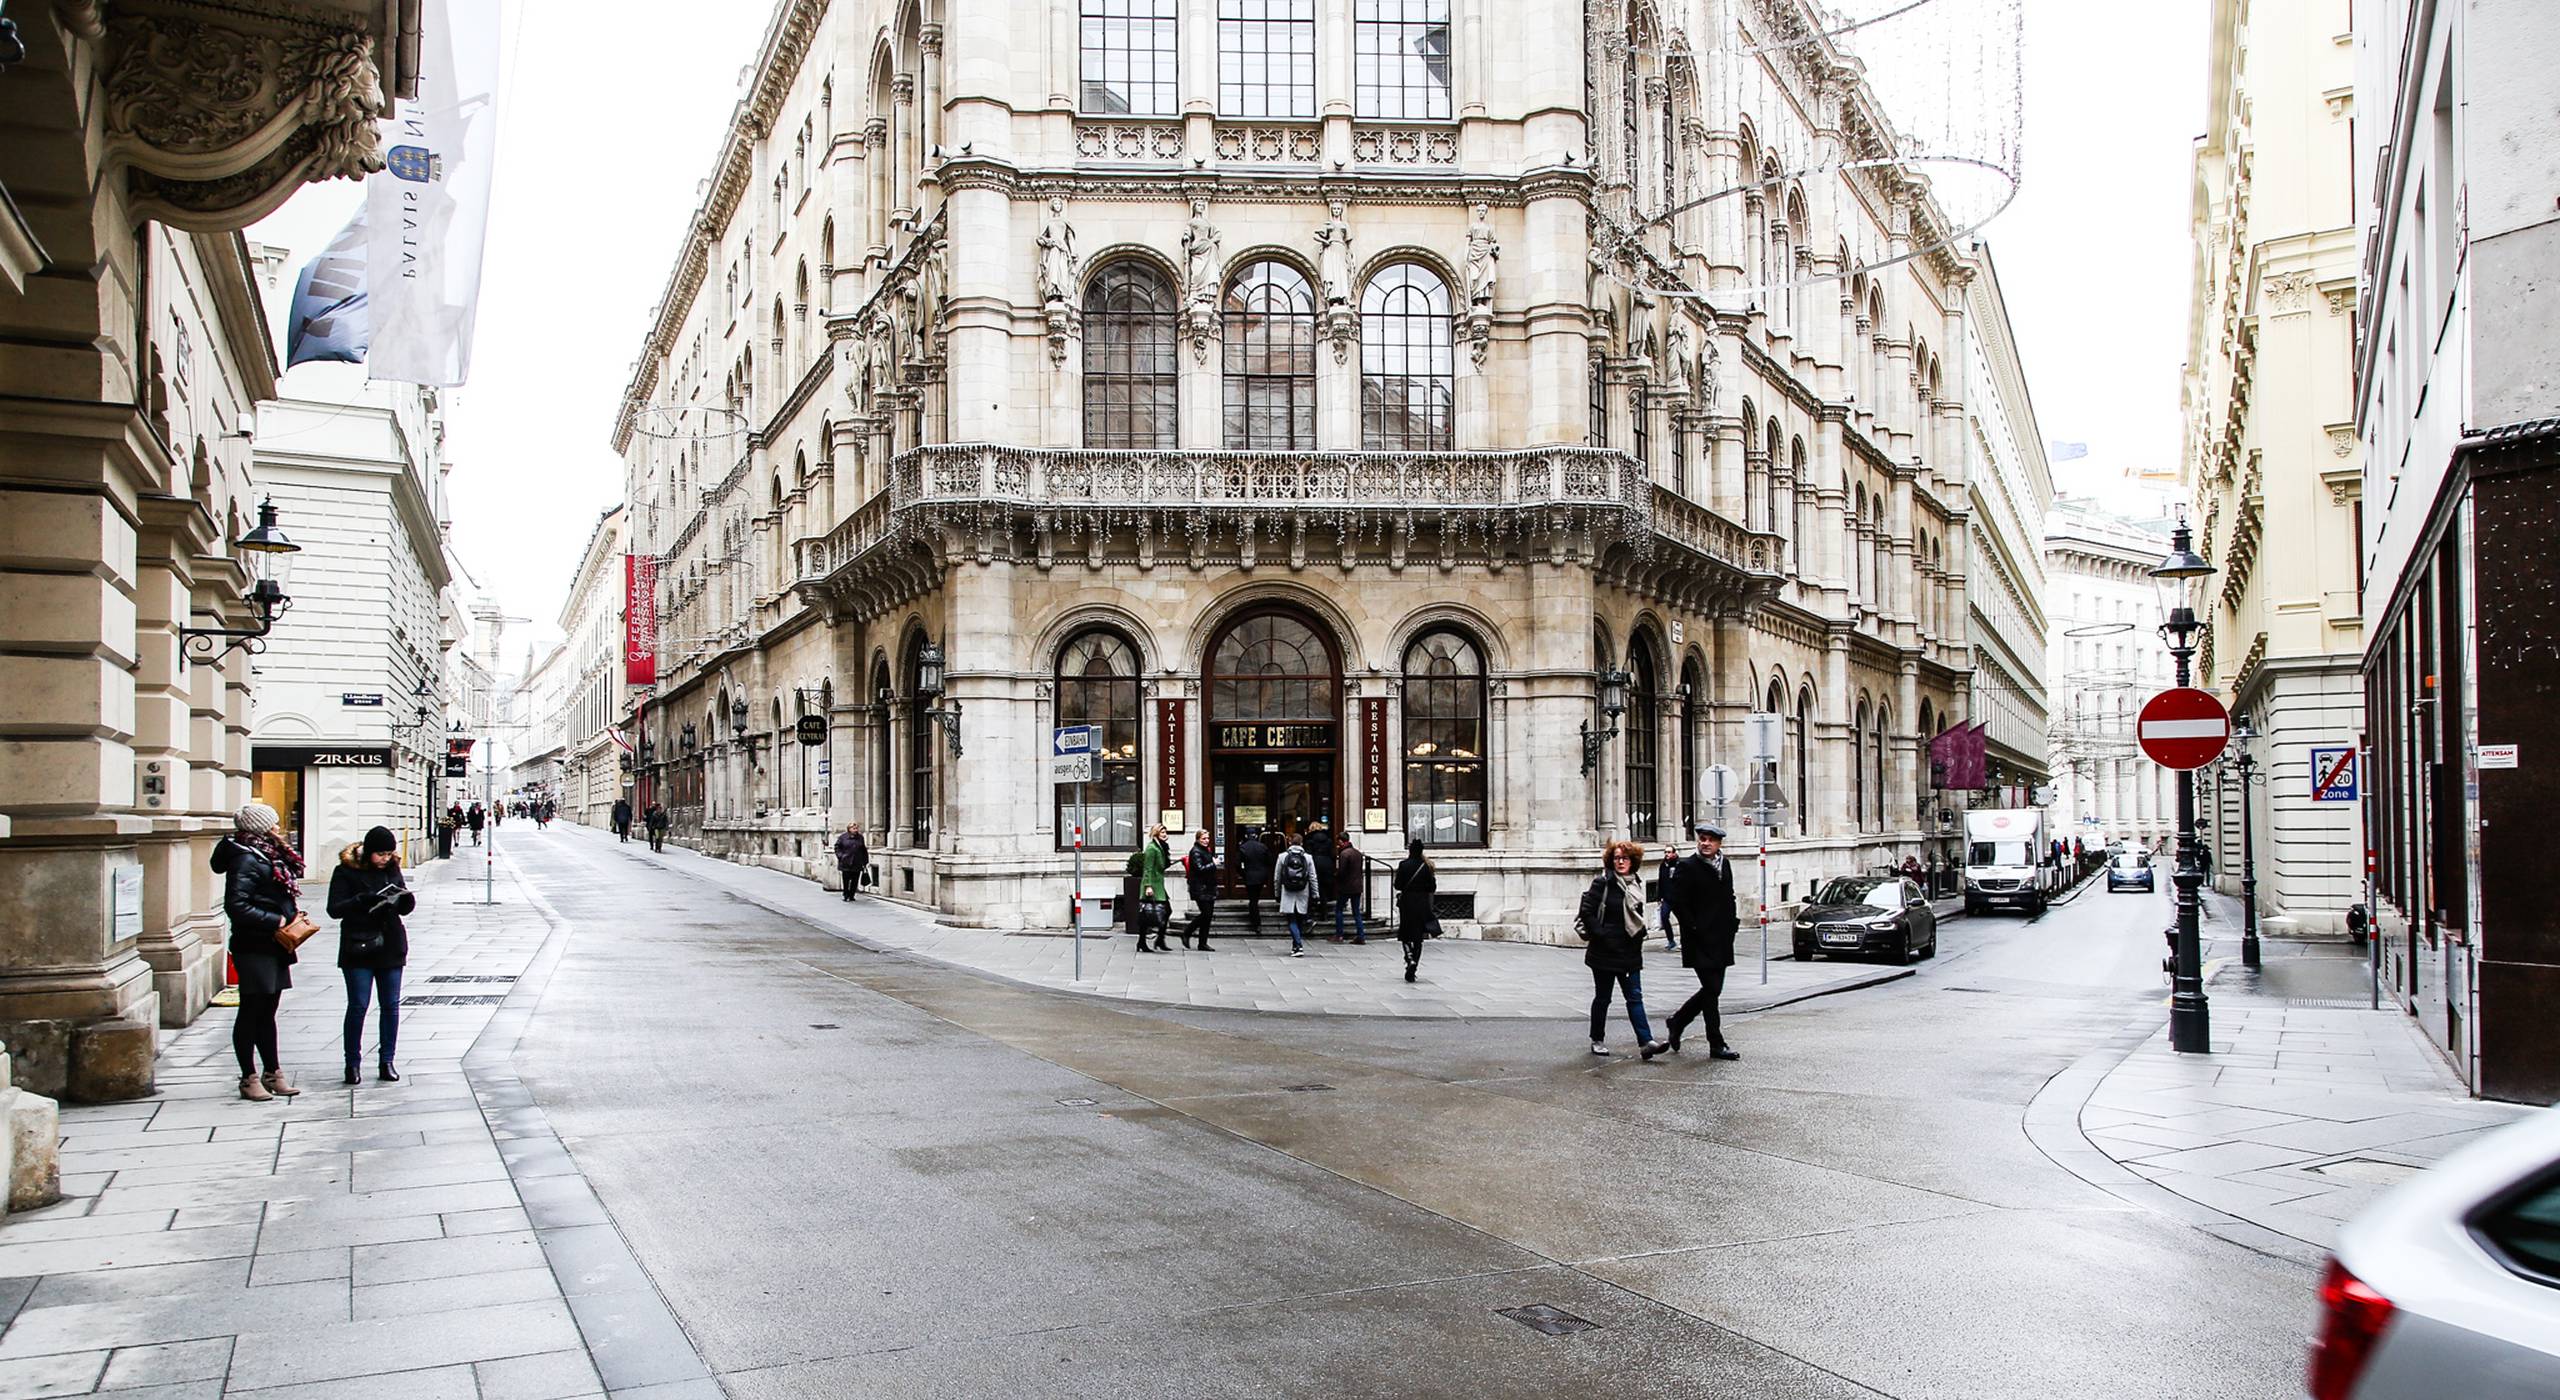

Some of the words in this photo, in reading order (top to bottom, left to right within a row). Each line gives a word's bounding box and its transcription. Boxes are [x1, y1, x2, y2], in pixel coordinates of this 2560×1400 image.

[1222, 727, 1257, 747] CAFE
[313, 754, 383, 765] ZIRKUS
[1168, 702, 1177, 808] PATISSERIE
[1370, 701, 1379, 807] RESTAURANT
[2337, 773, 2351, 785] 20
[2321, 789, 2349, 799] Zone
